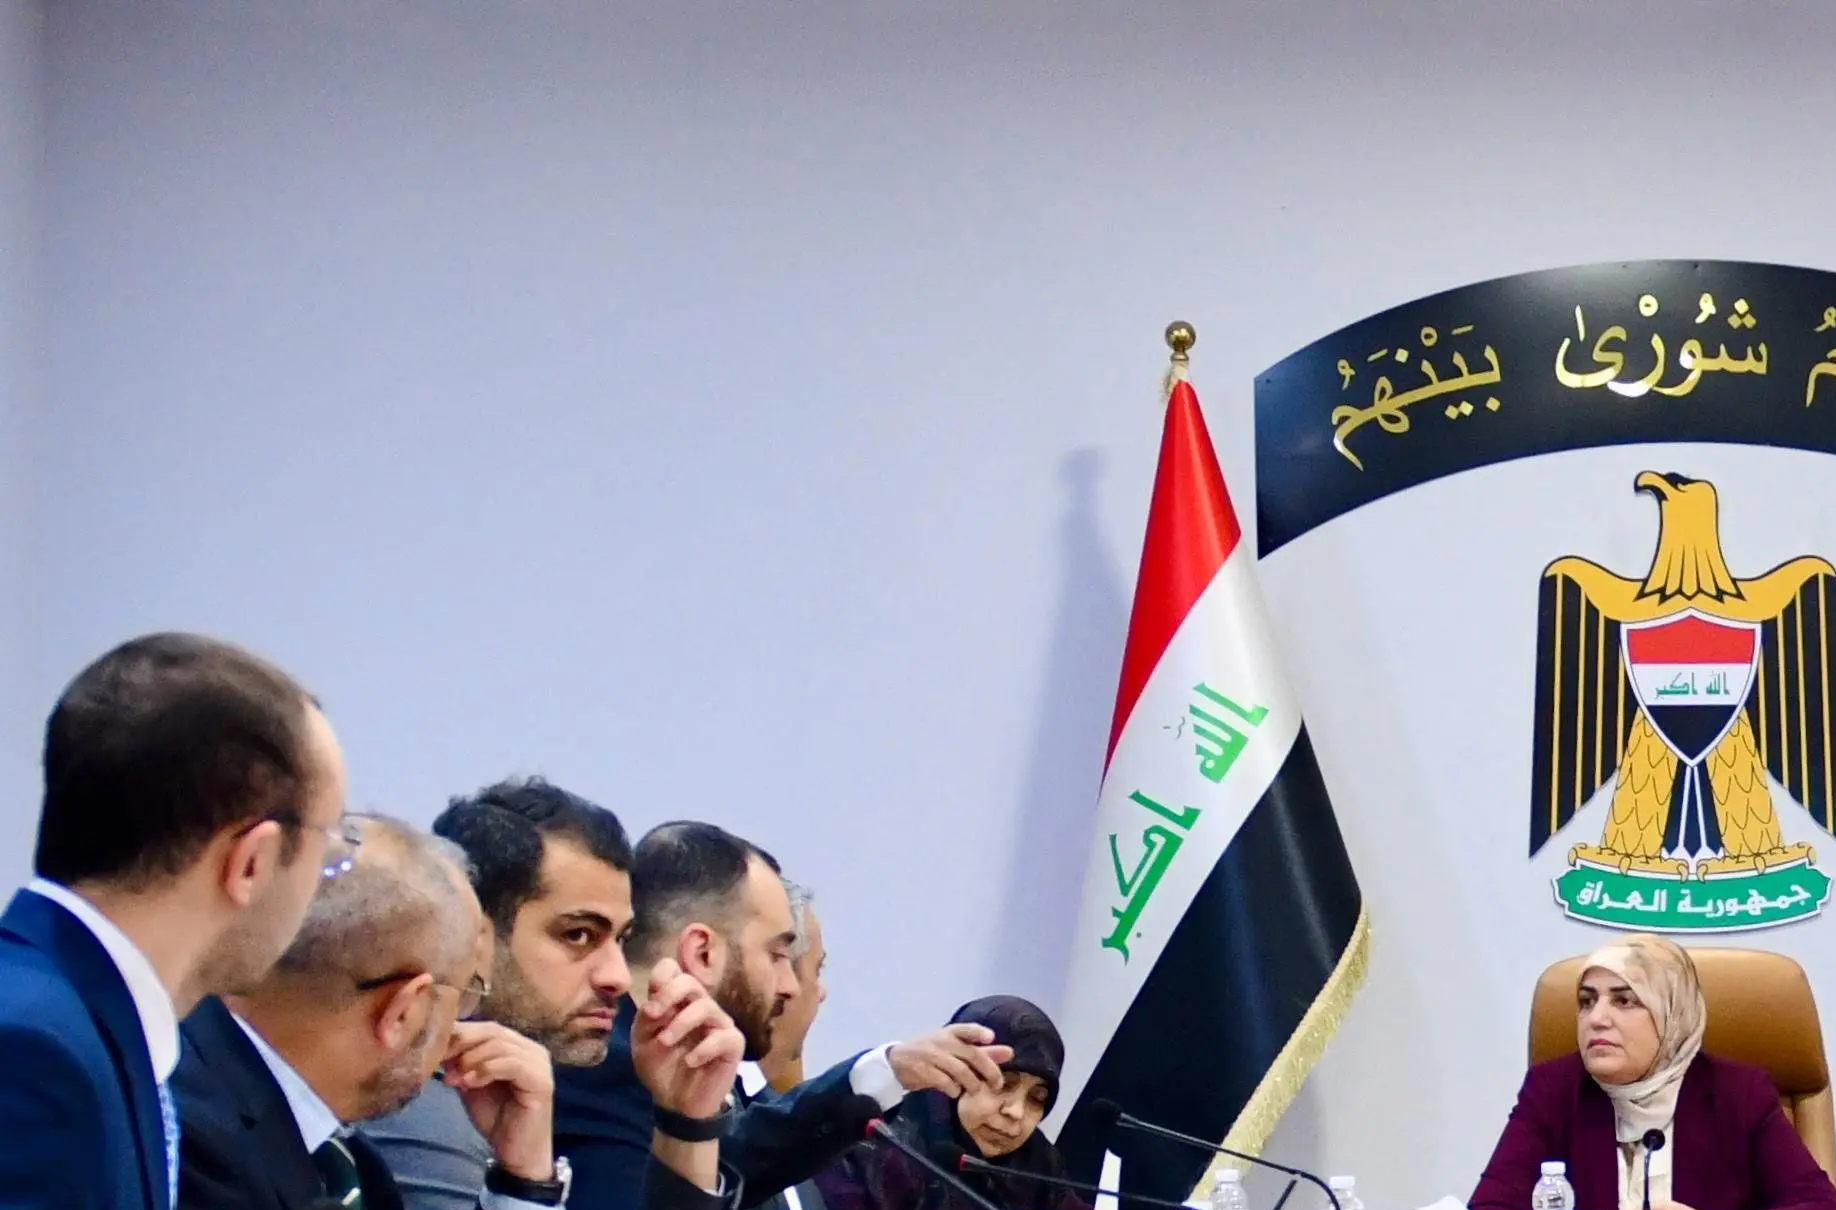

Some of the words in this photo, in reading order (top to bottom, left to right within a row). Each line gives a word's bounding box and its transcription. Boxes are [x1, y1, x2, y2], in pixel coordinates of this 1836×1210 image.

[1706, 670, 1731, 695] الله
[1162, 682, 1270, 783] الله
[1576, 881, 1667, 912] العراق
[1677, 884, 1812, 917] جمهورية
